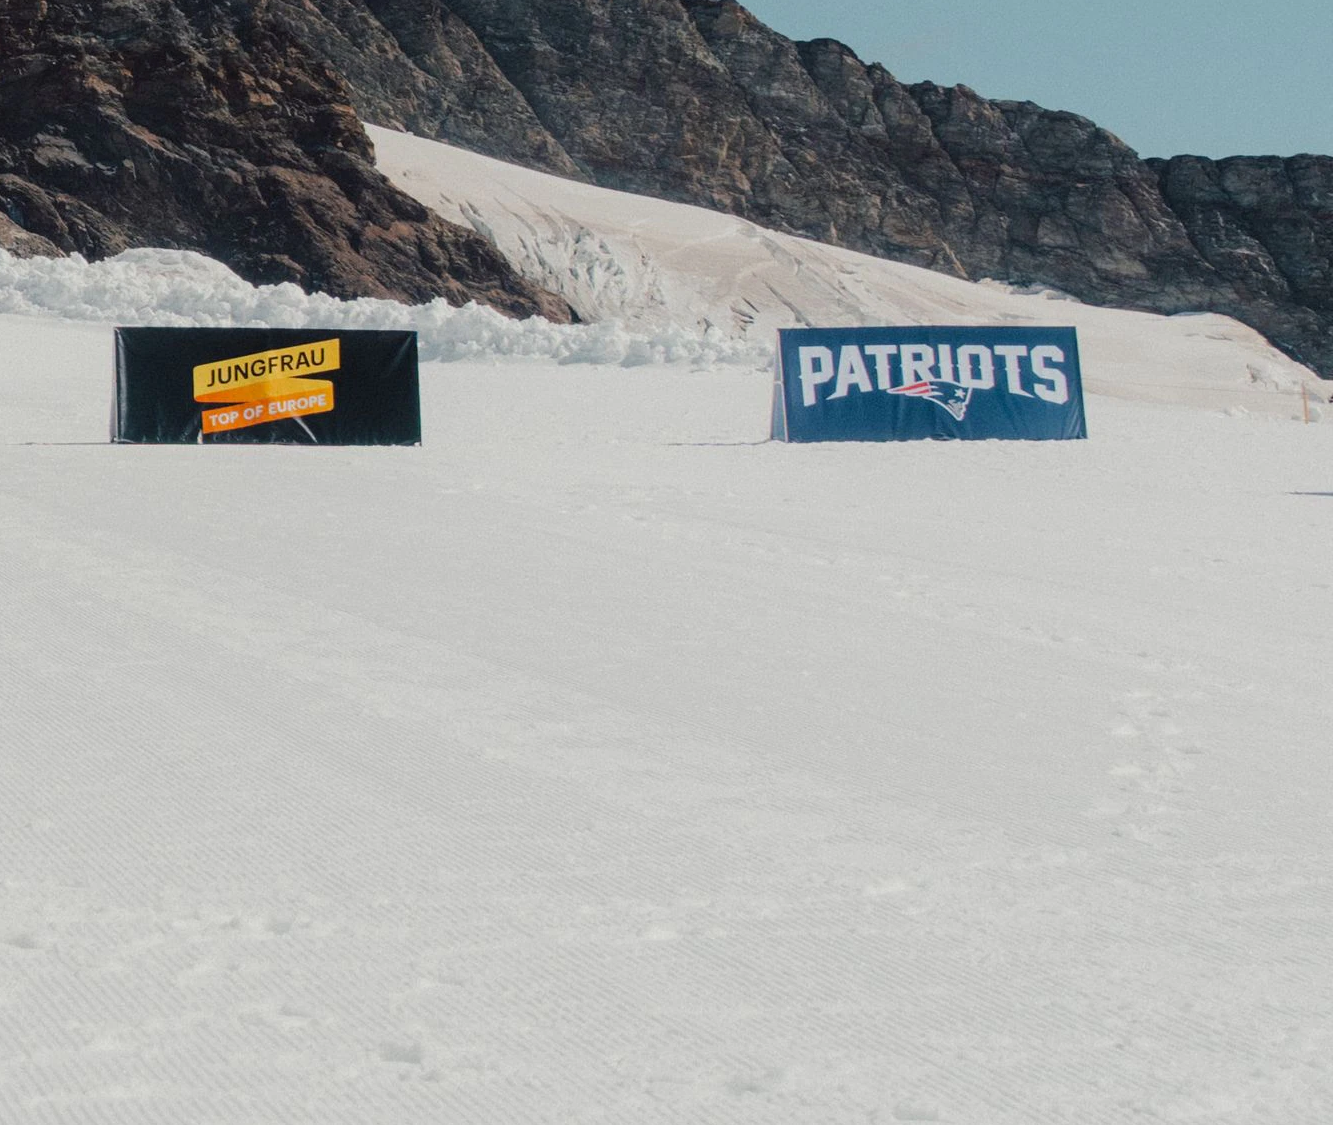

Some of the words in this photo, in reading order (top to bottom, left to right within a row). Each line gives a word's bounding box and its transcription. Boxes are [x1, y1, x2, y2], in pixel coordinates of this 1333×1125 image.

[206, 348, 326, 388] JUNGFRAU
[798, 344, 1069, 407] PATRIOTS
[208, 412, 239, 427] TOP
[243, 406, 264, 421] OF
[268, 394, 327, 416] EUROPE
